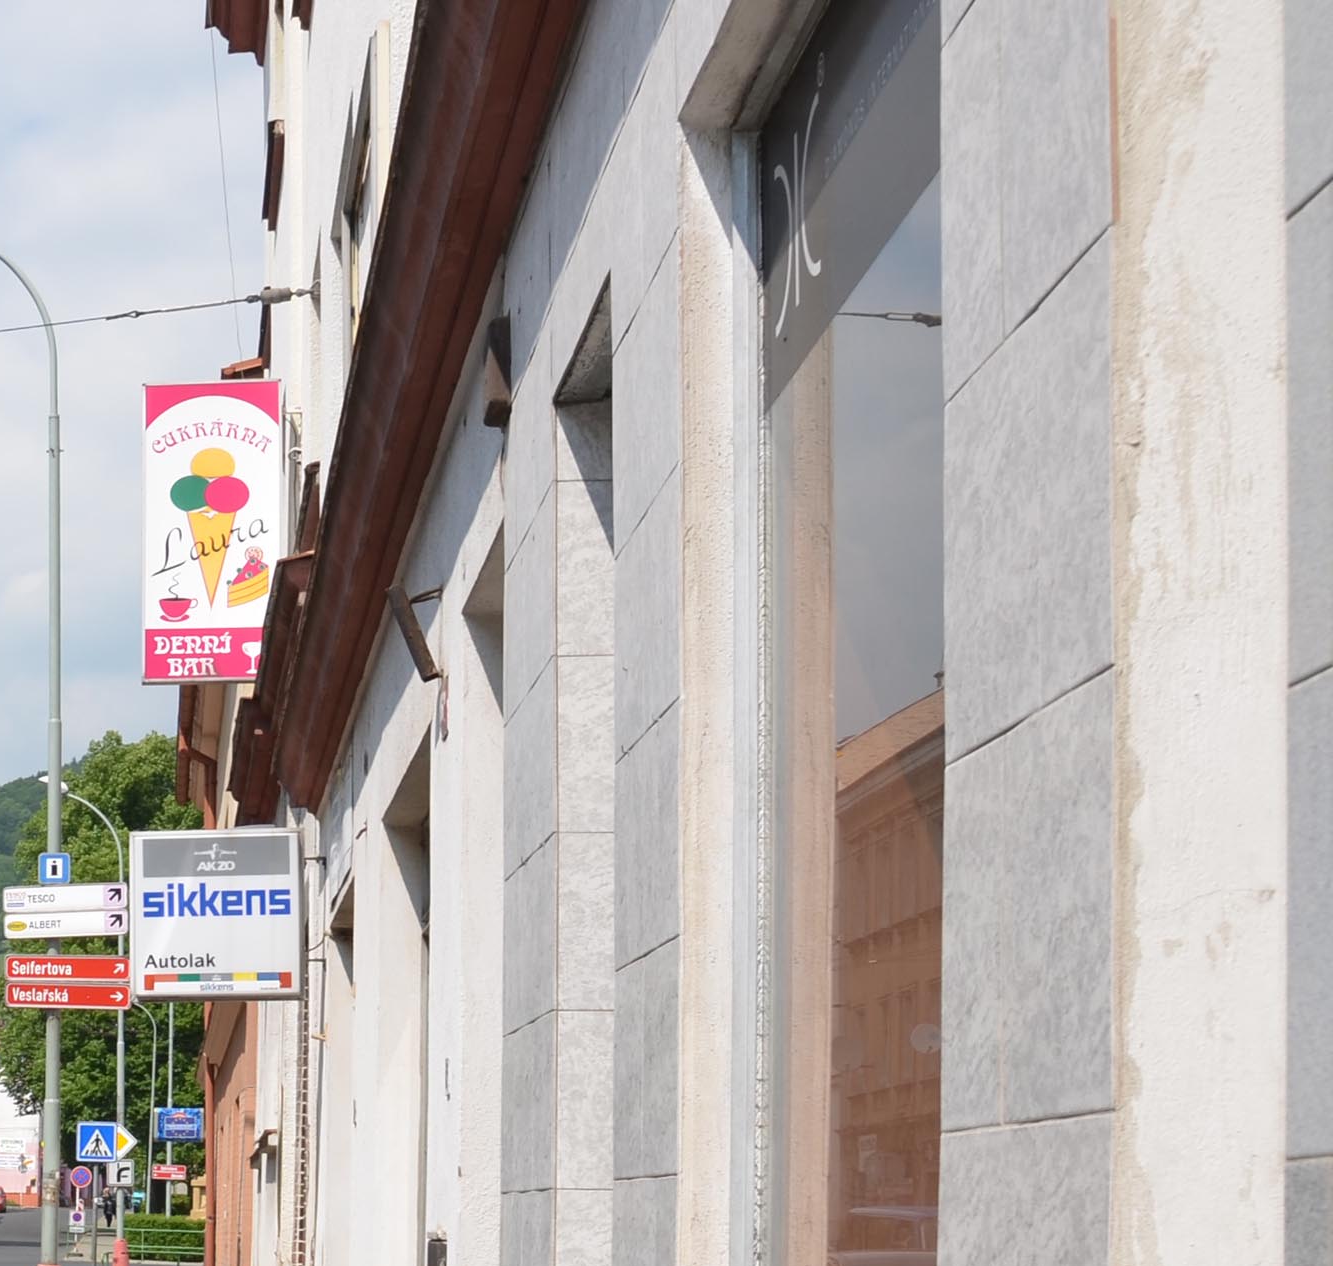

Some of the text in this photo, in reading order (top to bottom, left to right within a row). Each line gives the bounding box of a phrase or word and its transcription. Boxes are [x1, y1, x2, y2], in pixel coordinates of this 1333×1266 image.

[151, 418, 272, 454] CUKRÁRNA
[151, 518, 269, 577] Laura
[154, 632, 232, 655] DENNÍ
[167, 657, 217, 677] BAR
[196, 861, 236, 872] AKZO
[28, 894, 56, 904] TESCO
[143, 883, 291, 918] sikkens
[29, 919, 62, 930] ALBERT
[11, 961, 72, 975] Seifertova
[144, 953, 217, 969] Autolak
[12, 987, 69, 1003] Veslařská
[200, 983, 234, 992] sikkens
